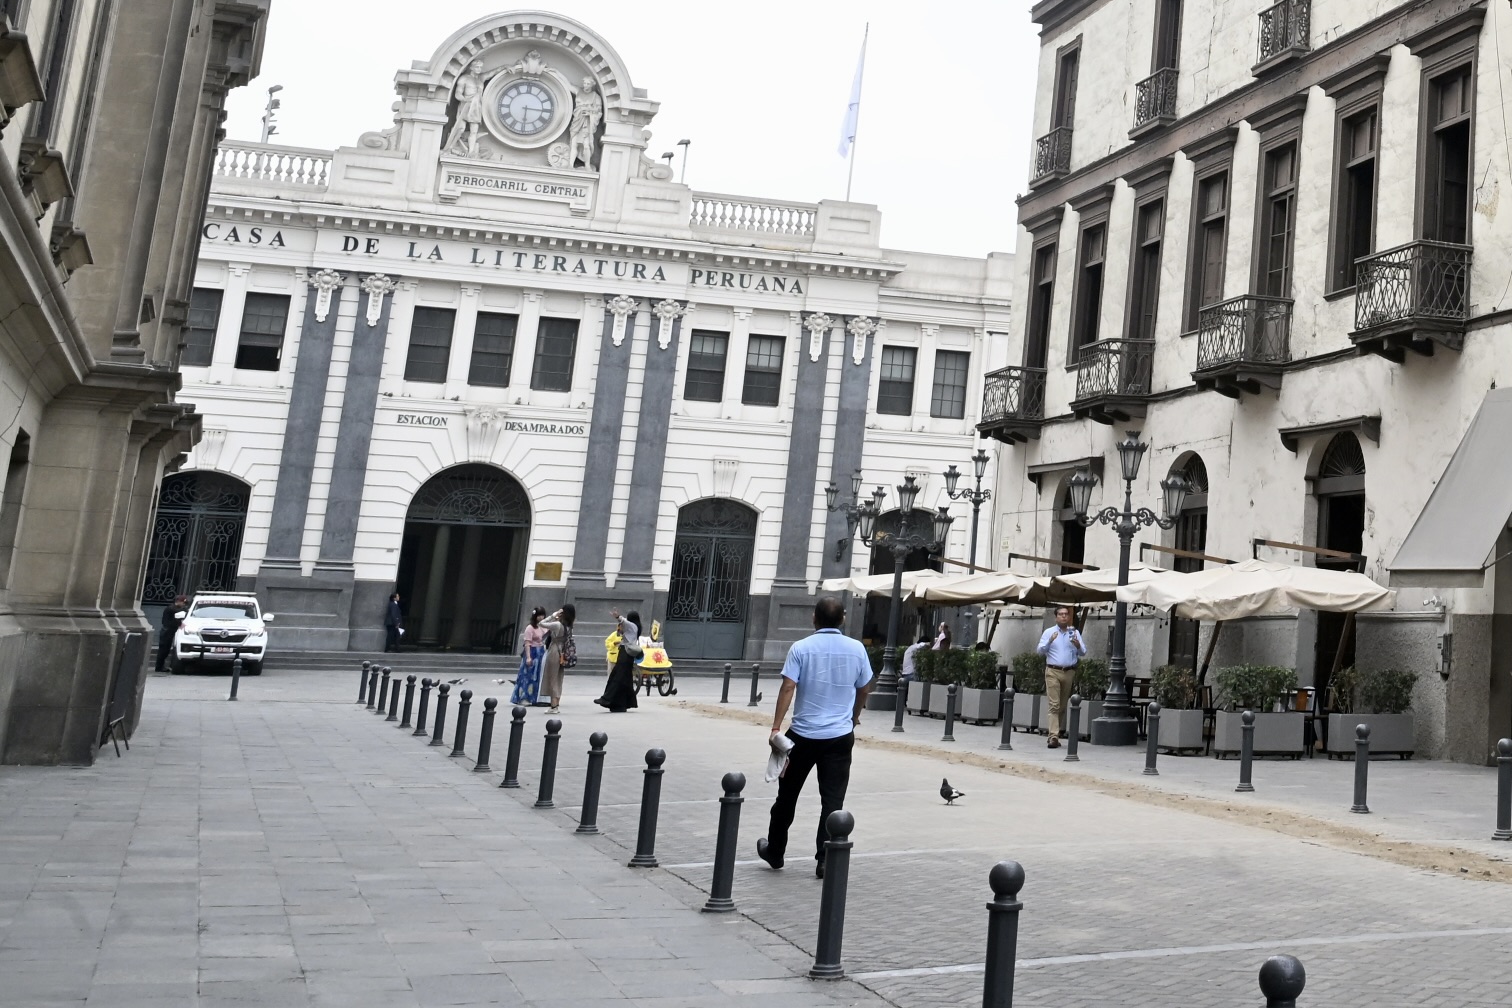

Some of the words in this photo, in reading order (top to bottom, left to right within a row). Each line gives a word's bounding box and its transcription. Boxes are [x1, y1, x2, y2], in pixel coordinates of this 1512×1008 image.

[447, 174, 528, 191] FERROCARRIL
[534, 184, 586, 197] CENTRAL
[203, 223, 286, 247] CASA
[342, 235, 380, 255] DE
[408, 242, 444, 261] LA
[471, 247, 667, 282] LITERATURA
[690, 268, 803, 294] PERUANA
[397, 414, 448, 427] ESTACION
[504, 422, 584, 435] DESAMPARADOS
